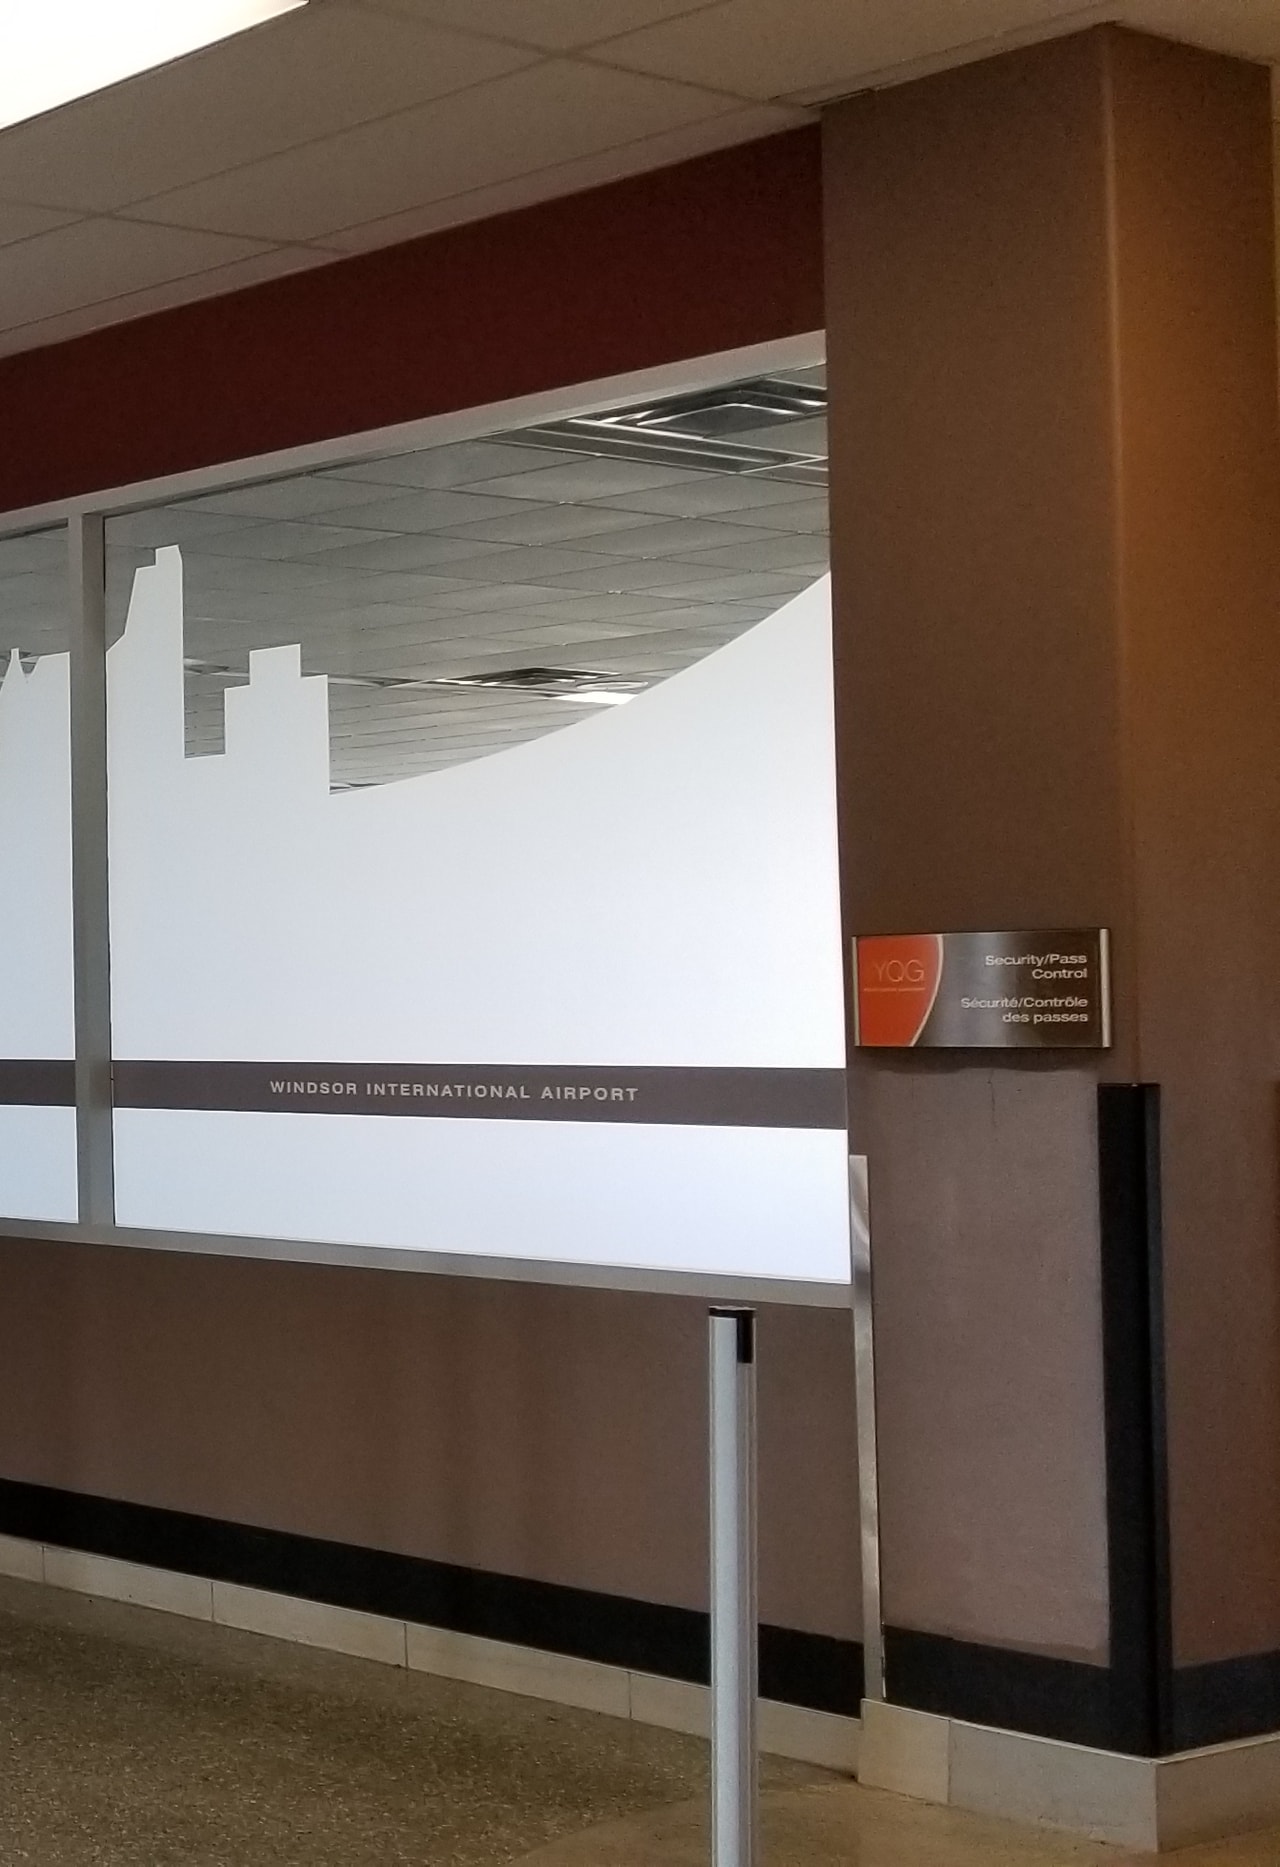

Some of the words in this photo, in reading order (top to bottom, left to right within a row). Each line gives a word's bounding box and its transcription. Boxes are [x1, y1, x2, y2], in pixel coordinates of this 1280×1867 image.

[984, 953, 1088, 968] Security/Pass
[874, 959, 925, 982] YQG
[1031, 968, 1088, 979] Control
[960, 996, 1089, 1009] Sécurité/Contrôle
[1002, 1012, 1030, 1023] des
[1033, 1014, 1089, 1025] passes
[269, 1080, 358, 1096] WINDSOR
[366, 1082, 531, 1099] INTERNATIONAL
[540, 1086, 639, 1102] AIRPORT
